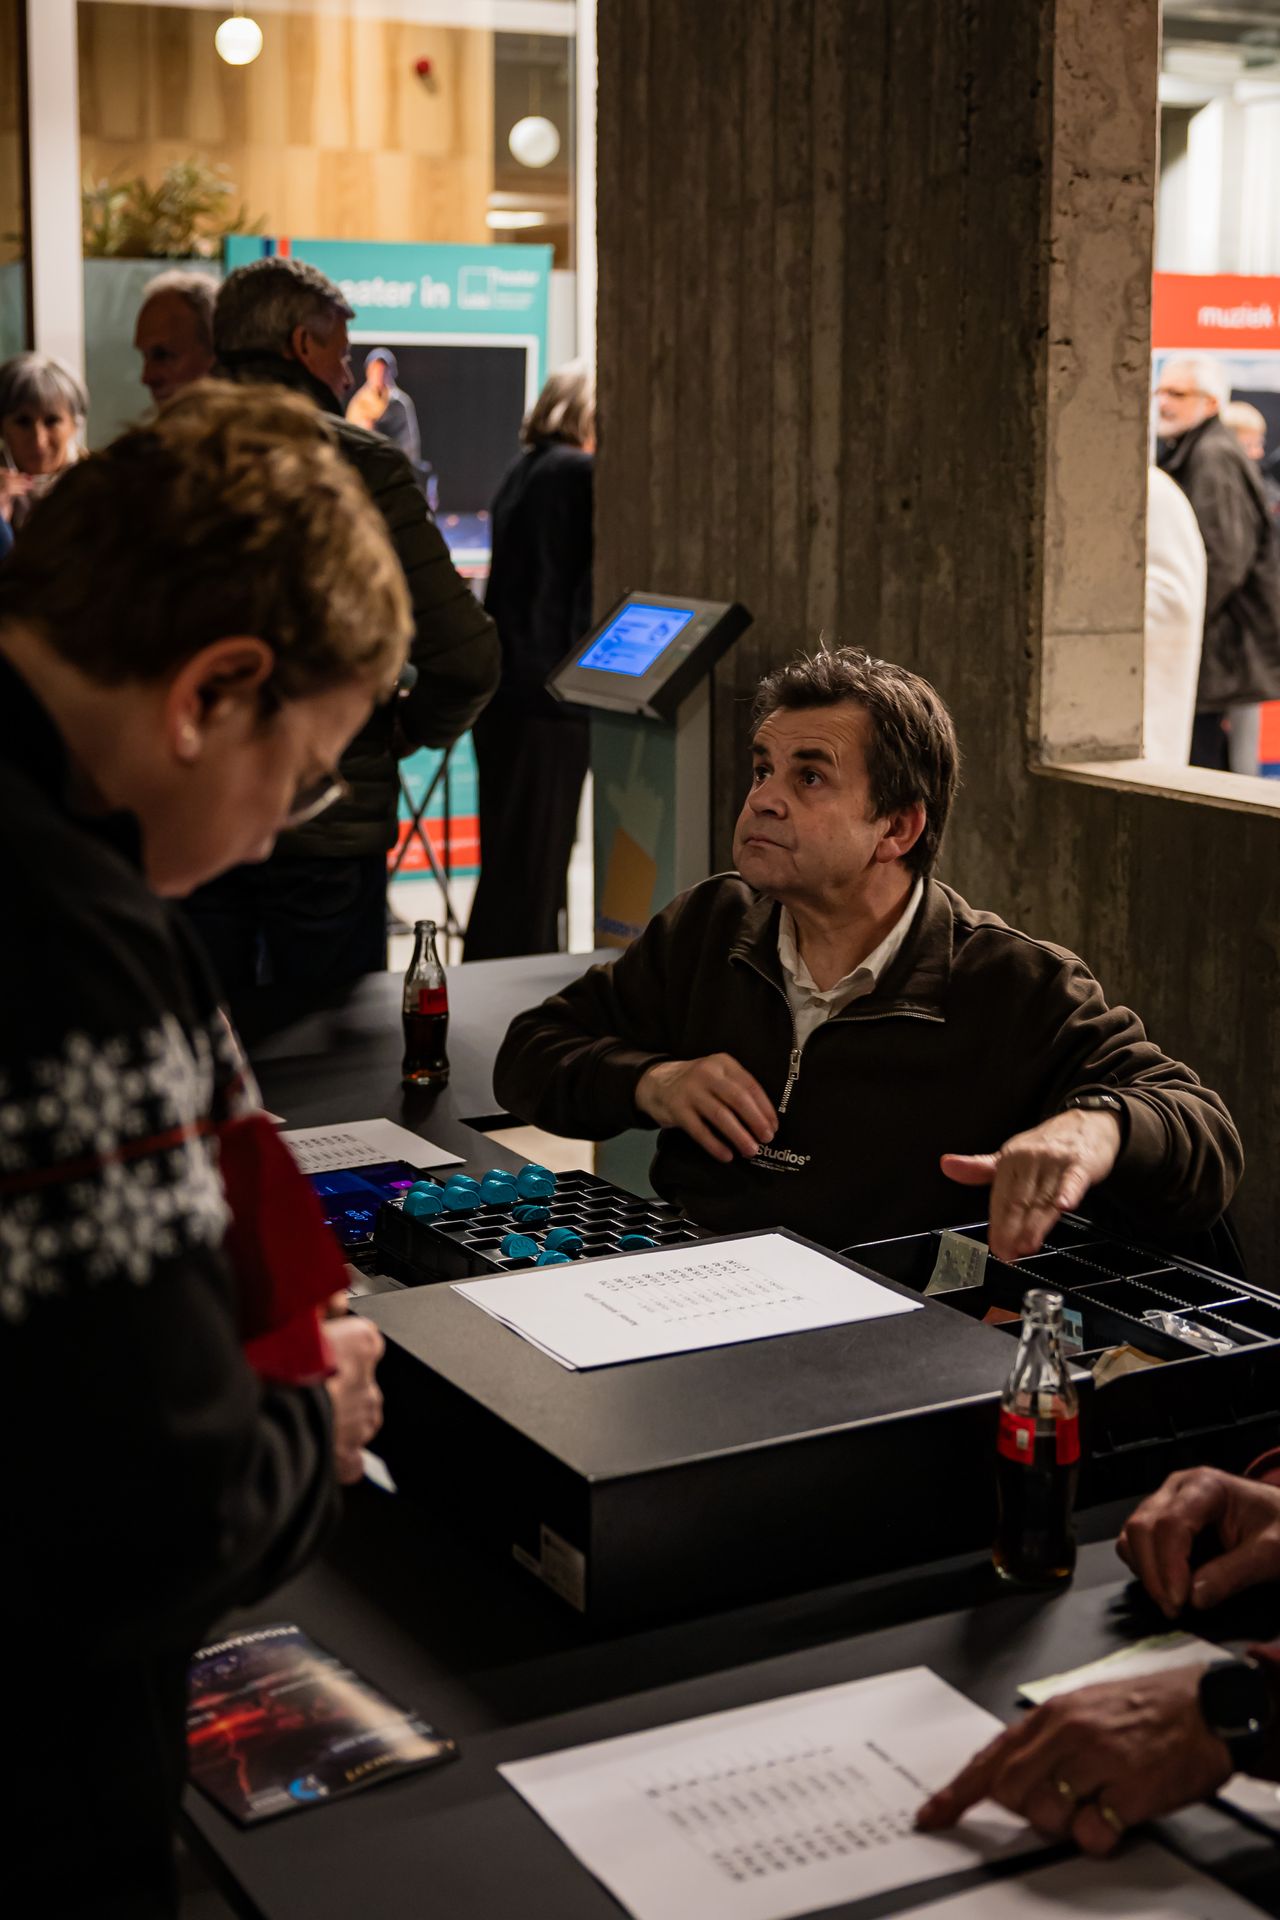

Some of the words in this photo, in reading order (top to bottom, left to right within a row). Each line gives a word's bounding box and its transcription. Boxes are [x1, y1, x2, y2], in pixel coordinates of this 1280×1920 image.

[338, 276, 416, 308] eater
[420, 275, 451, 309] in
[1198, 303, 1272, 328] muziek
